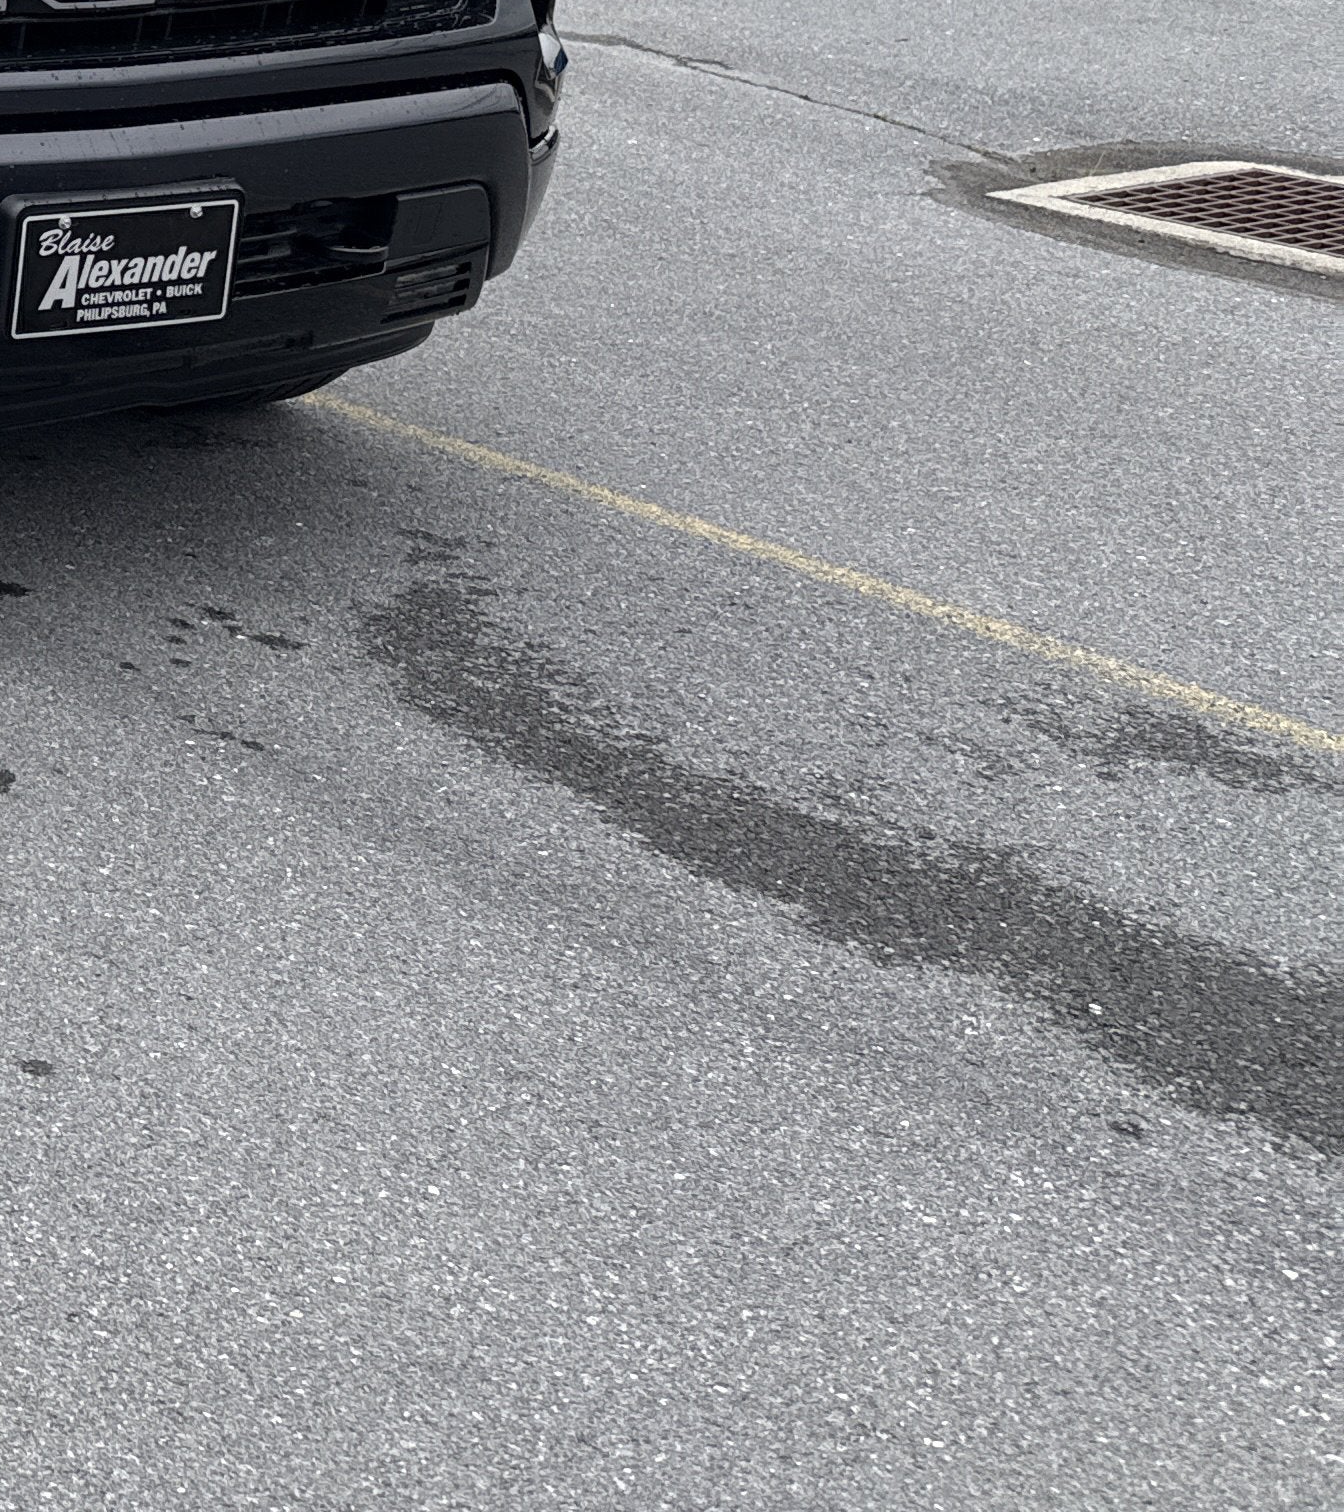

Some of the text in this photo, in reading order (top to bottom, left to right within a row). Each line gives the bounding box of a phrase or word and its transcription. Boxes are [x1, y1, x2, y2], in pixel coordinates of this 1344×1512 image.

[38, 228, 115, 257] Blaise
[37, 246, 217, 311] Alexander
[81, 283, 203, 306] CHEVROLET BUICK
[152, 301, 168, 315] PA
